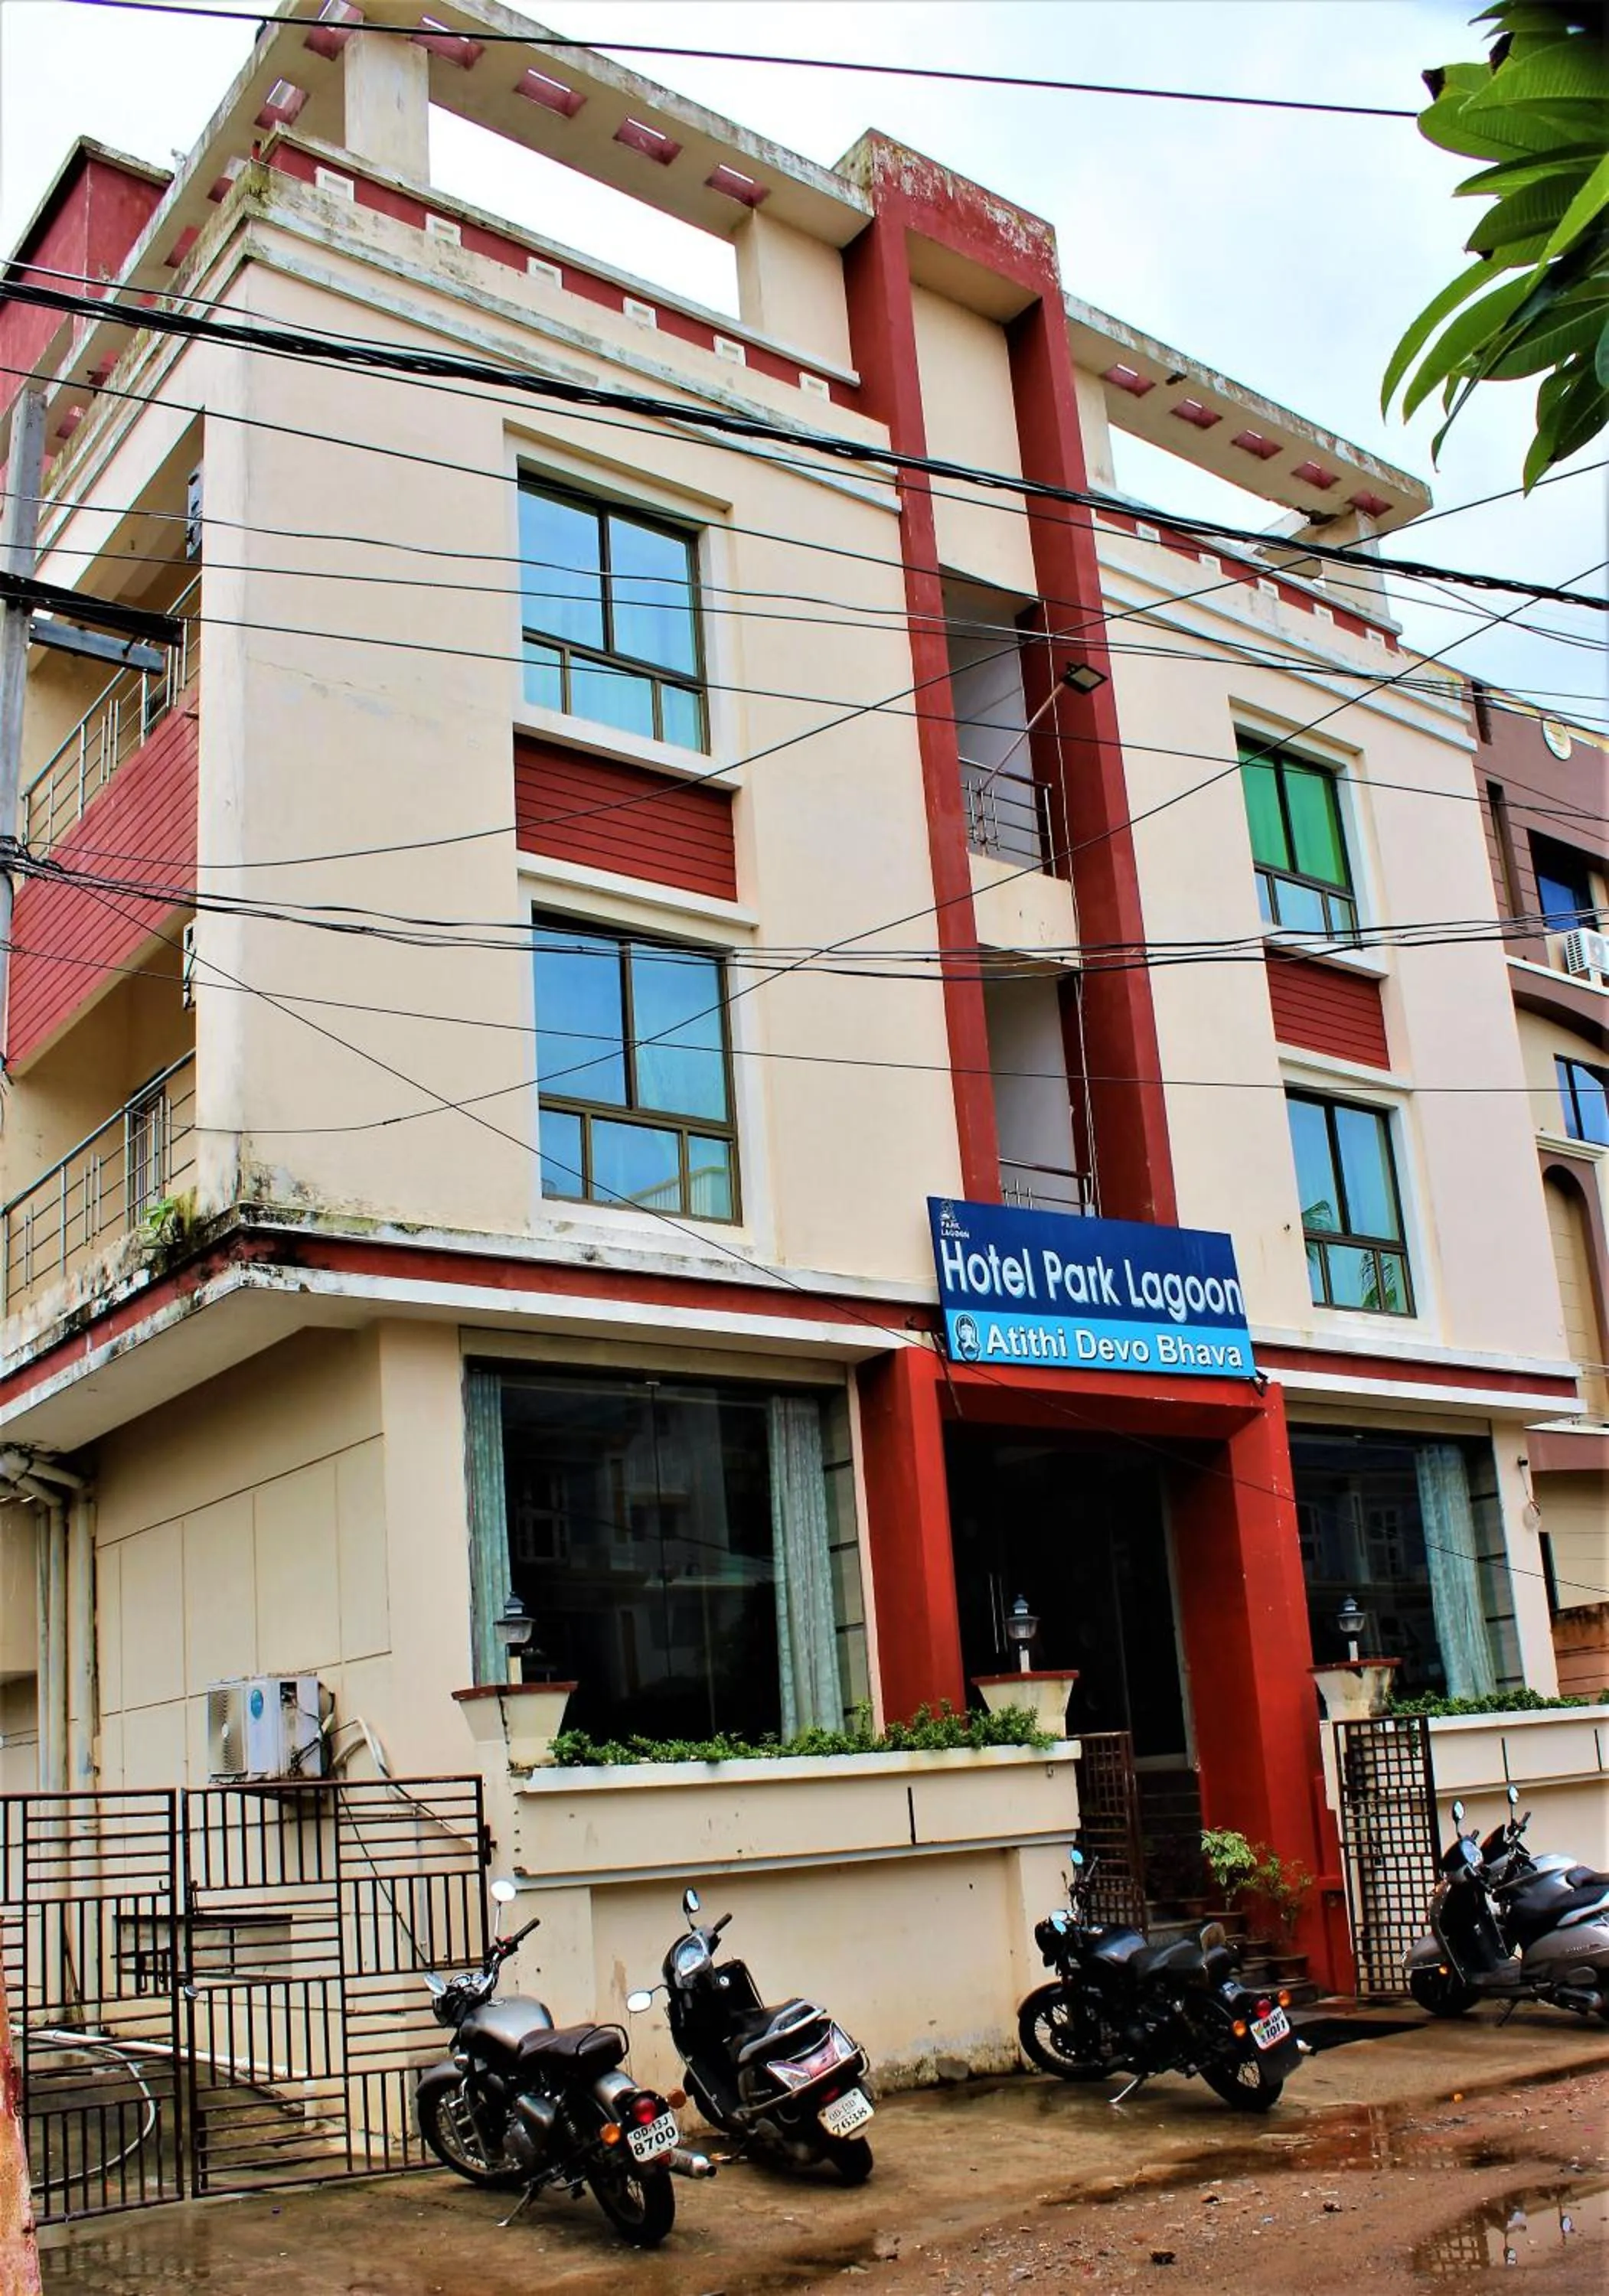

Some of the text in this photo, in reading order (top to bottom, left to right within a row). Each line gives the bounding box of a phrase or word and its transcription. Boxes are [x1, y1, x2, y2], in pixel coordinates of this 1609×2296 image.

[941, 1221, 961, 1230] PARK
[941, 1228, 970, 1239] LAGOON
[940, 1239, 1245, 1322] Hotel Park Lagoon
[987, 1323, 1243, 1368] Atithi Devo Bhava
[833, 2107, 867, 2135] 7638
[634, 2126, 675, 2155] 8700
